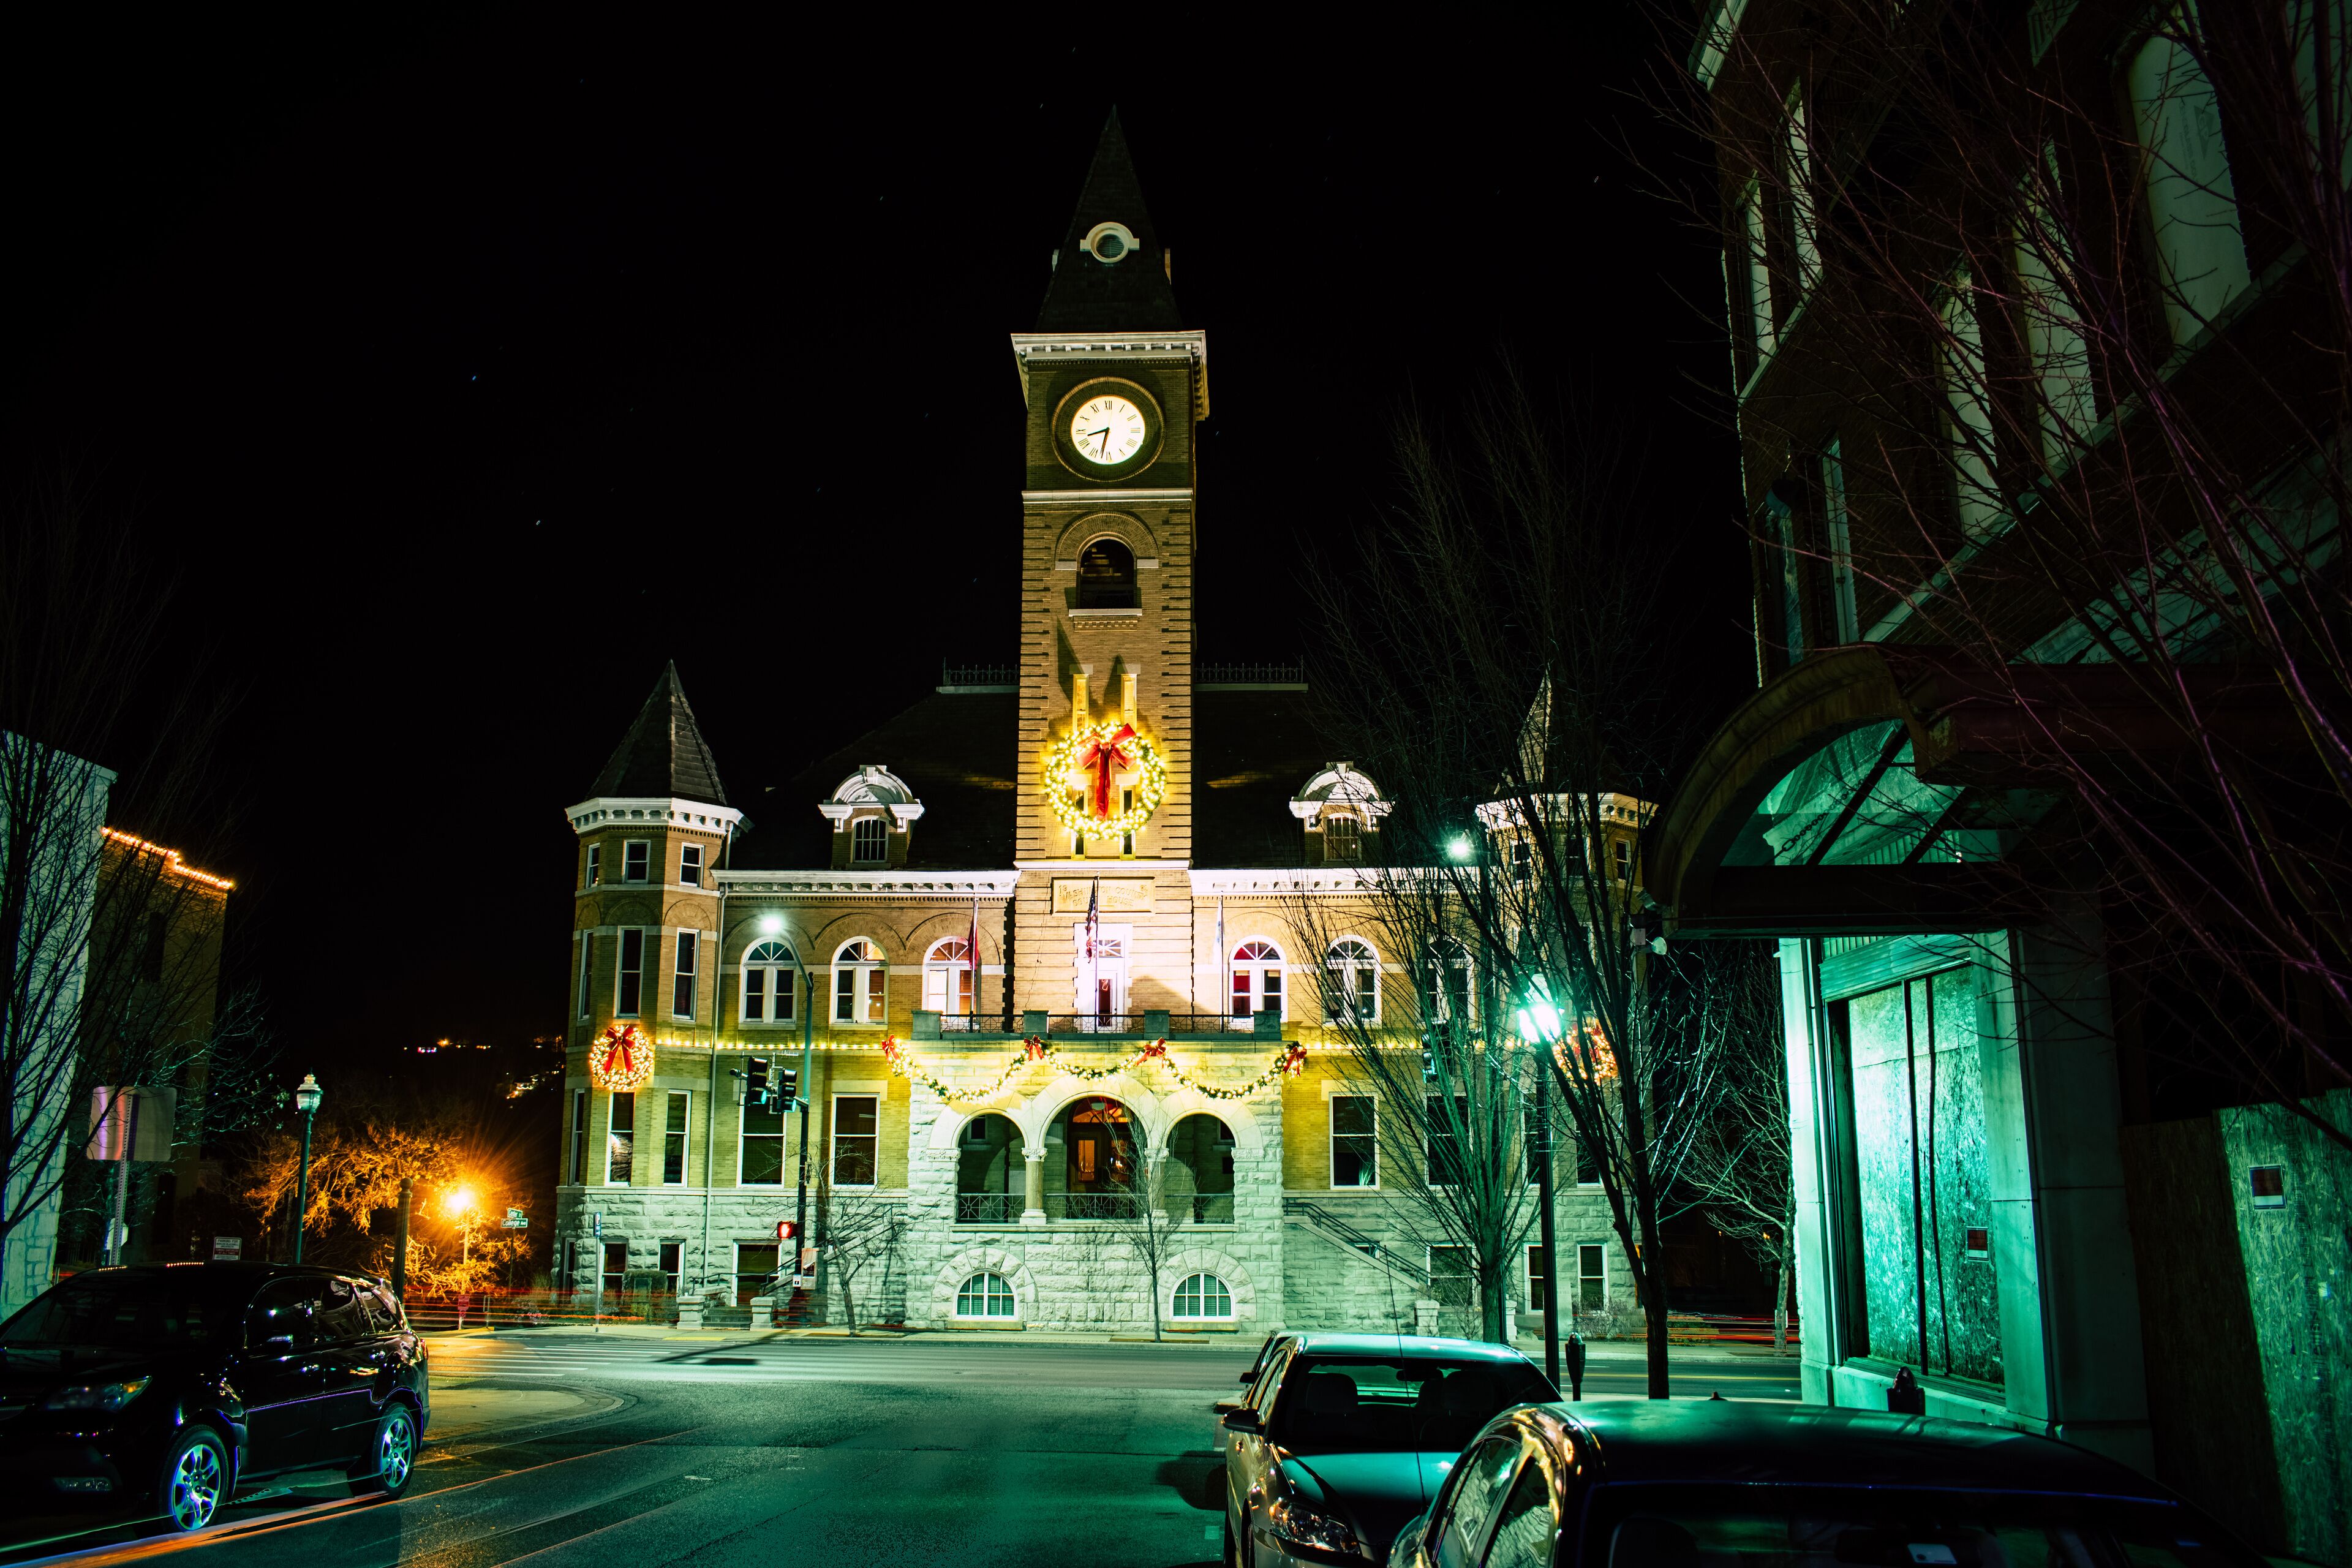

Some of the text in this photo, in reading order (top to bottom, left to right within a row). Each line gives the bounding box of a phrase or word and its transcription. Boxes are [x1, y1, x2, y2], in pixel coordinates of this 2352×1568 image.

[1060, 886, 1148, 902] WASHINTON COUNTY
[1107, 895, 1134, 907] HOUSE
